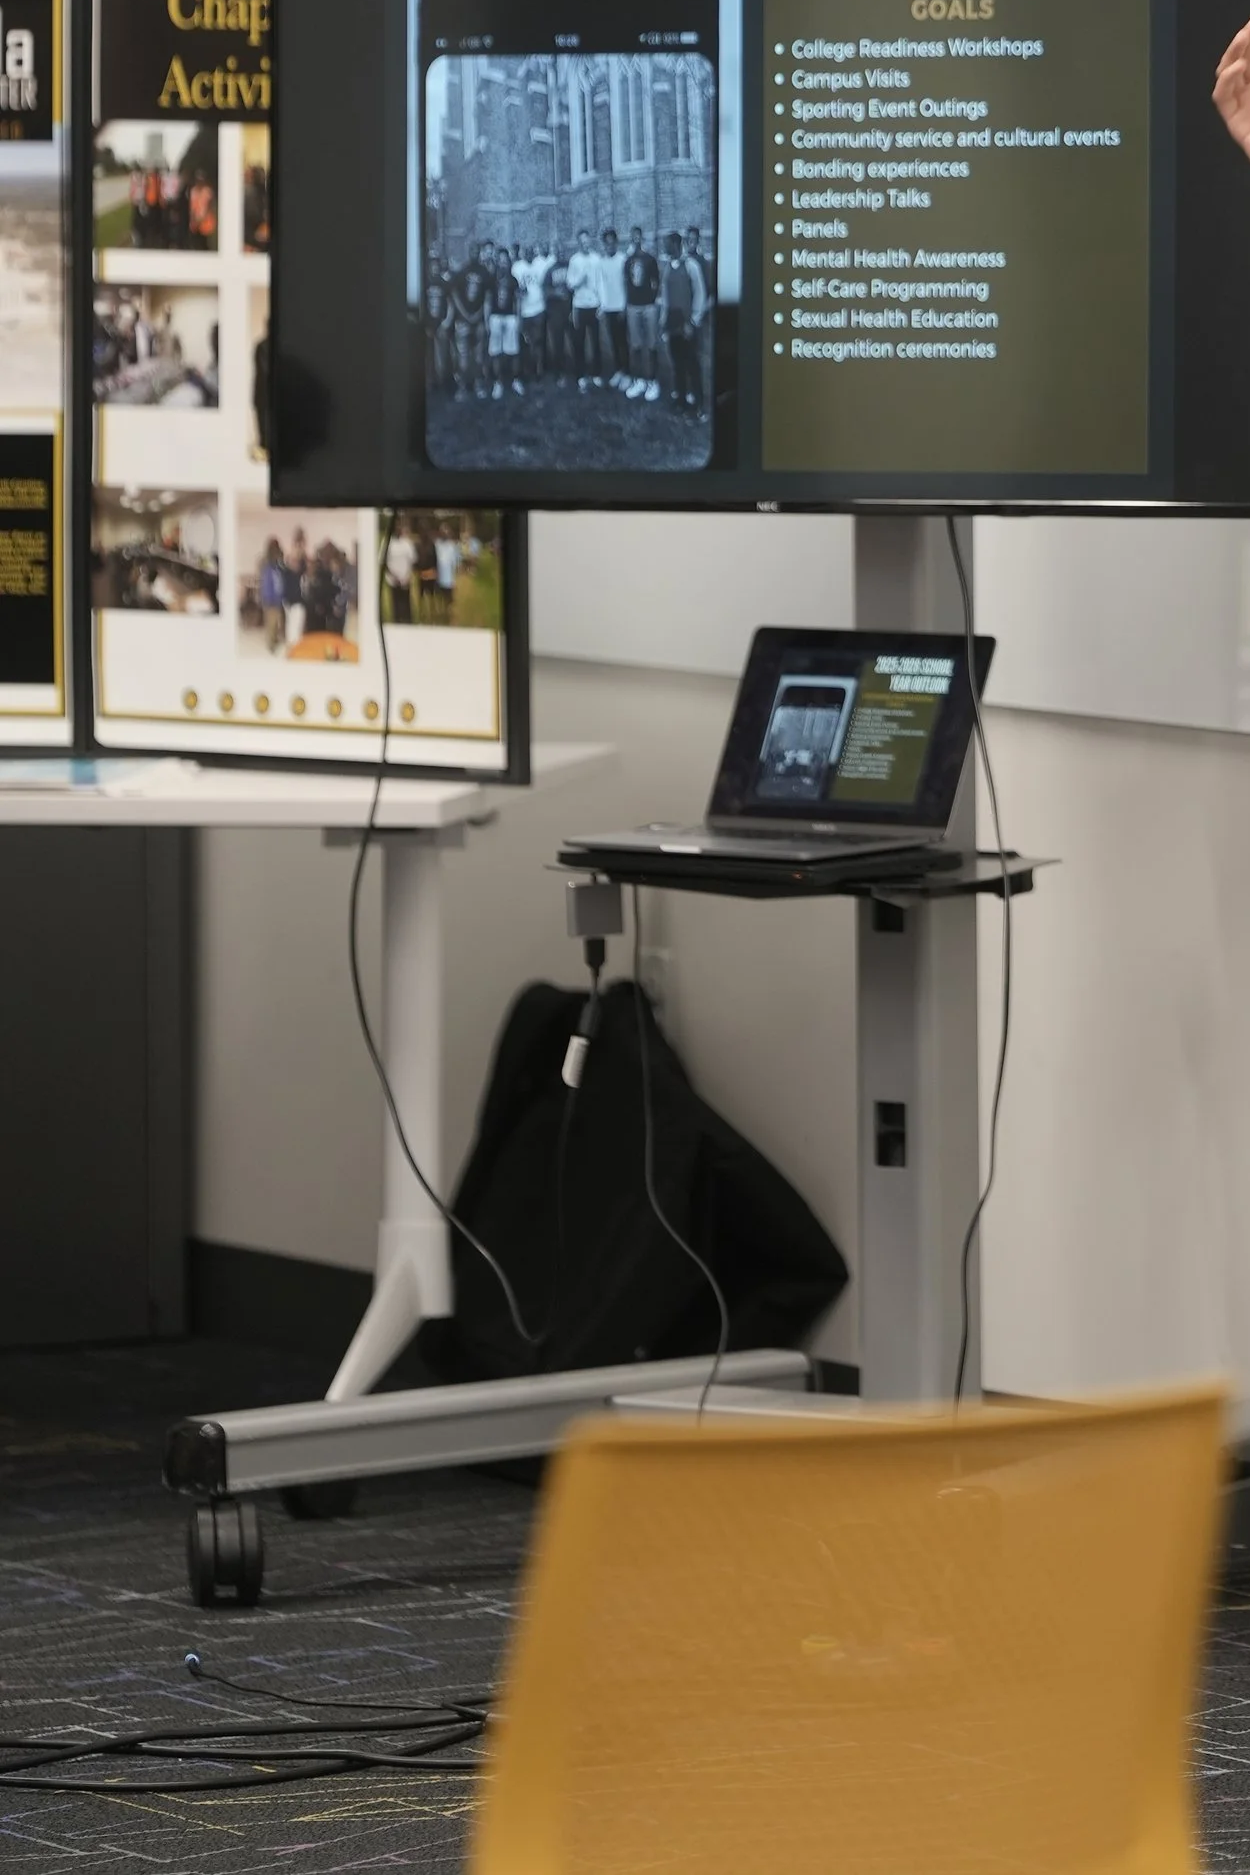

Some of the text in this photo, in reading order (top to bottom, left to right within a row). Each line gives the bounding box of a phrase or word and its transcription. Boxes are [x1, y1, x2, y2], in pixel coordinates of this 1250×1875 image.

[792, 37, 1044, 62] College Readiness Workshops
[792, 69, 911, 91] Campus Visits
[792, 98, 988, 122] Sporting Event Outings
[792, 127, 1121, 151] Community service and cultural events
[792, 159, 970, 182] Bonding experiences
[792, 188, 932, 211] Leadership Talks
[792, 218, 849, 239] Panels
[792, 248, 1006, 269] Mental Health Awareness
[791, 278, 990, 302] Self-Care Programming
[791, 308, 999, 329] Sexual Health Education
[792, 338, 998, 363] Recognition ceremonies
[756, 501, 779, 513] NEC
